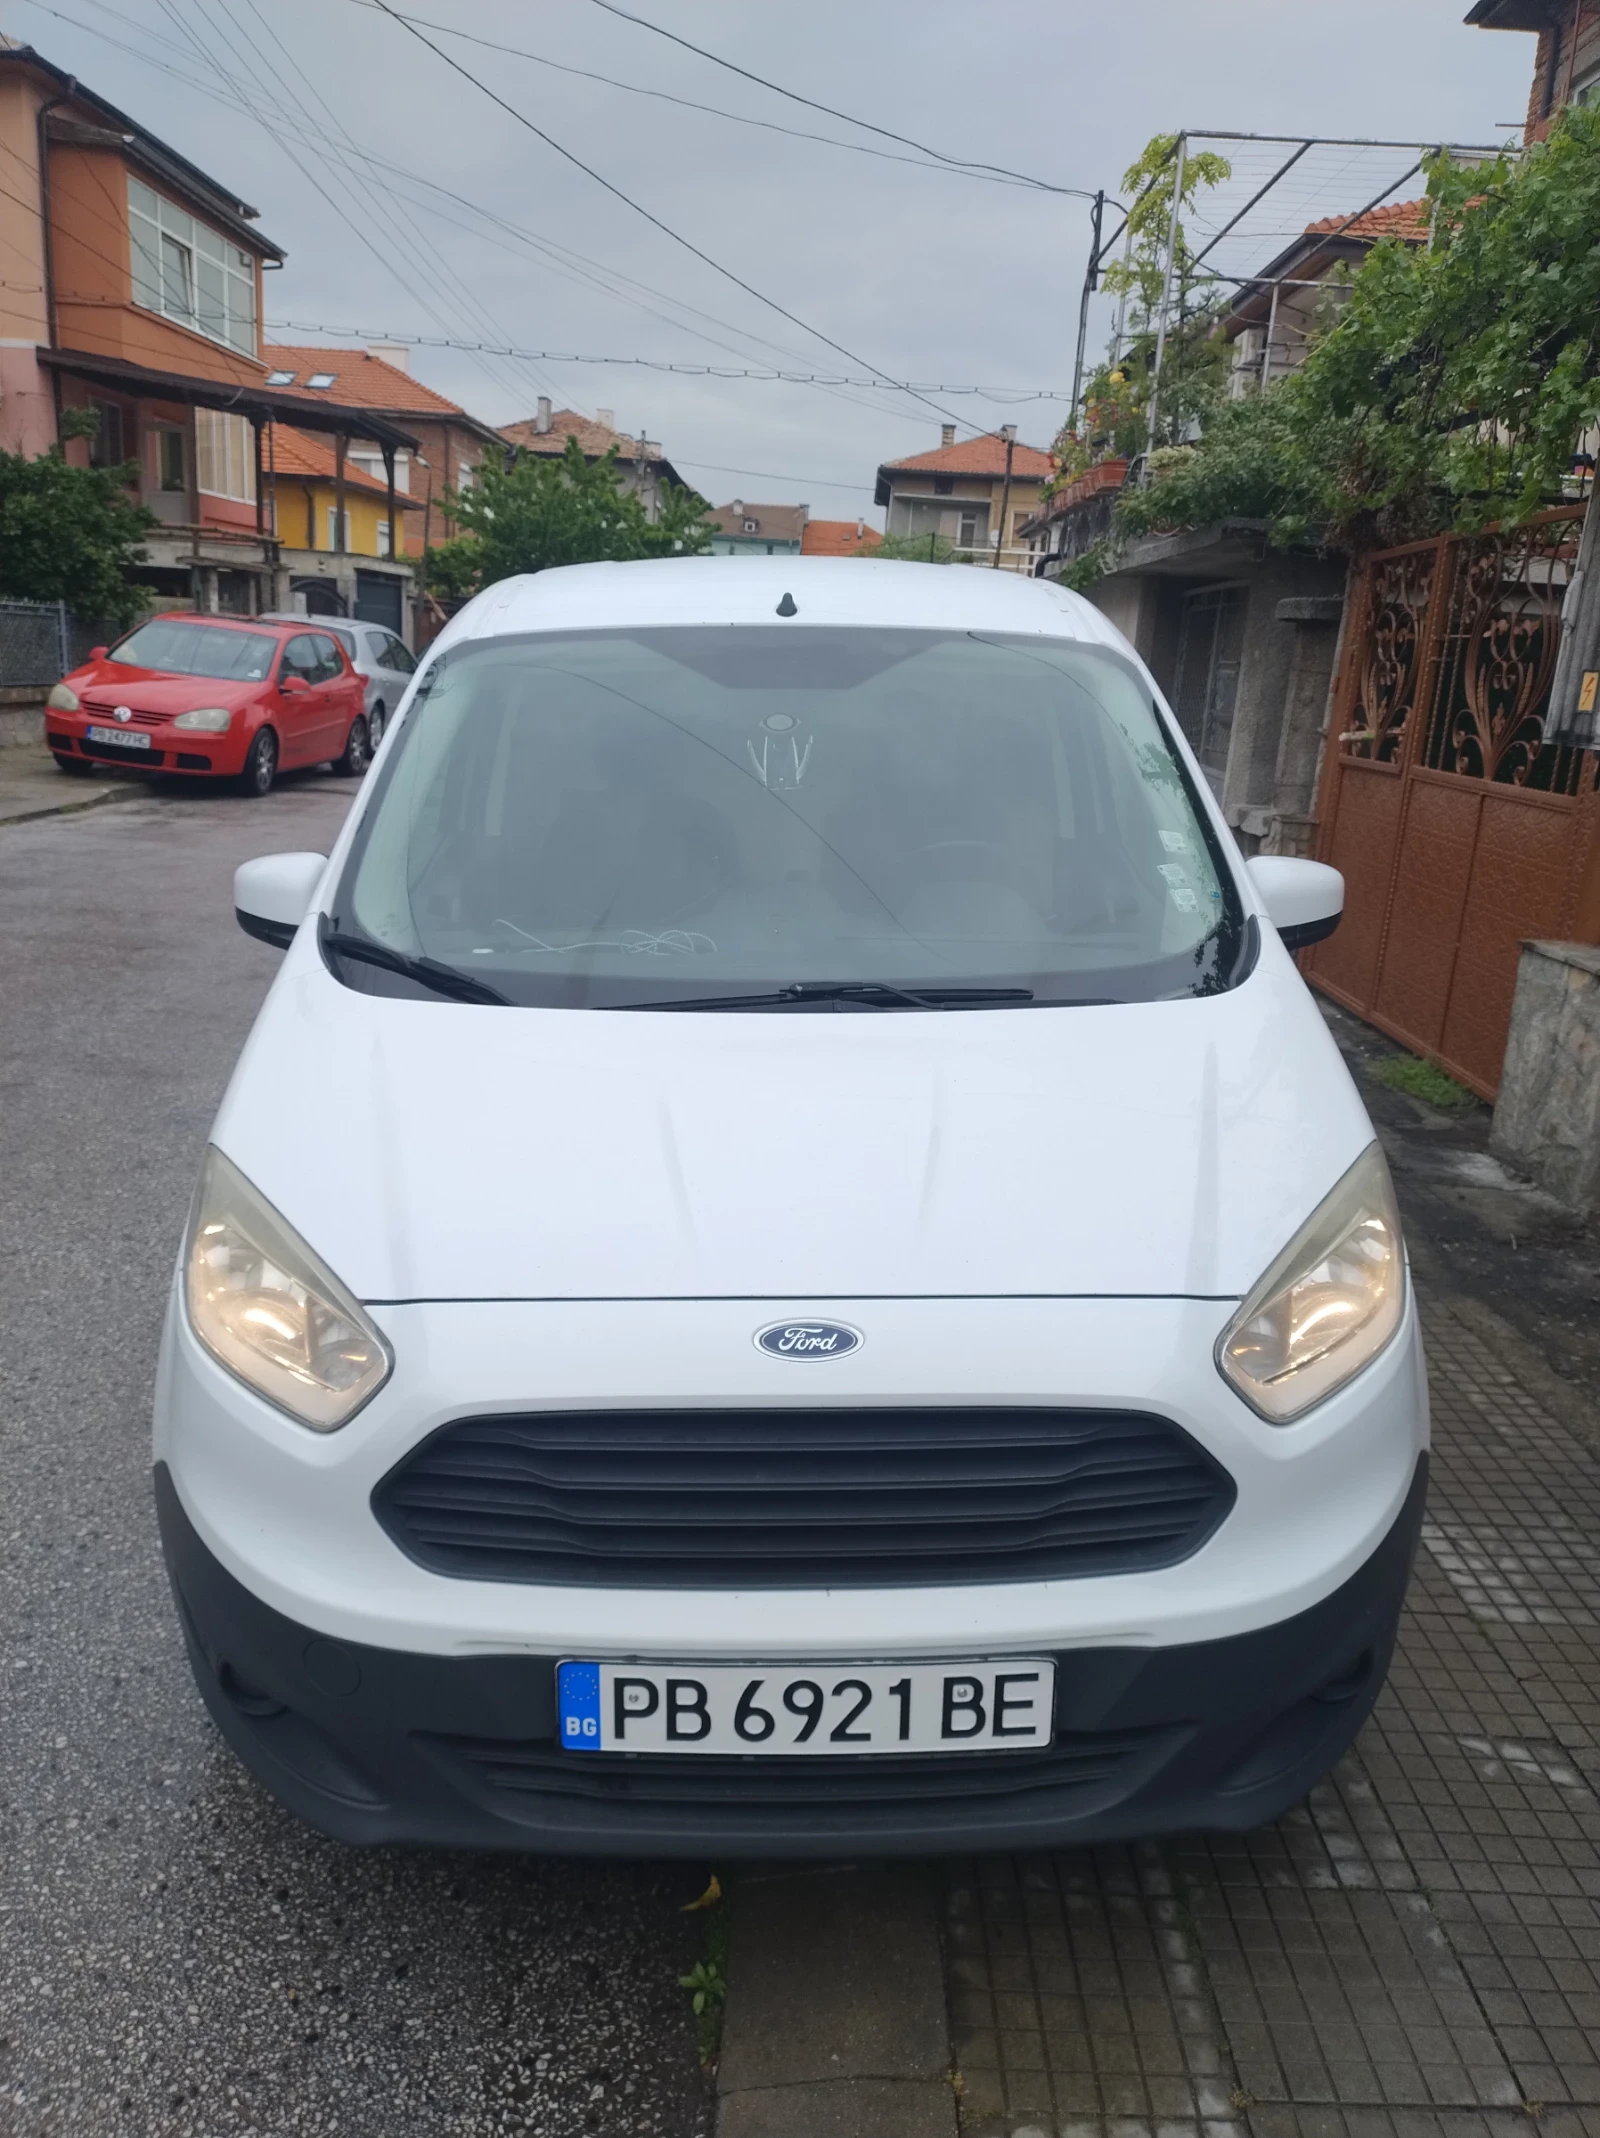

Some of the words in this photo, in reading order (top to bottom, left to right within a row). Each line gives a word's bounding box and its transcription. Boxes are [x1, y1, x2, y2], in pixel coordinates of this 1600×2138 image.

[778, 1327, 838, 1351] Ford
[614, 1677, 711, 1741] PB
[733, 1678, 912, 1743] 6921
[940, 1672, 1040, 1740] BE
[566, 1716, 597, 1736] BG
